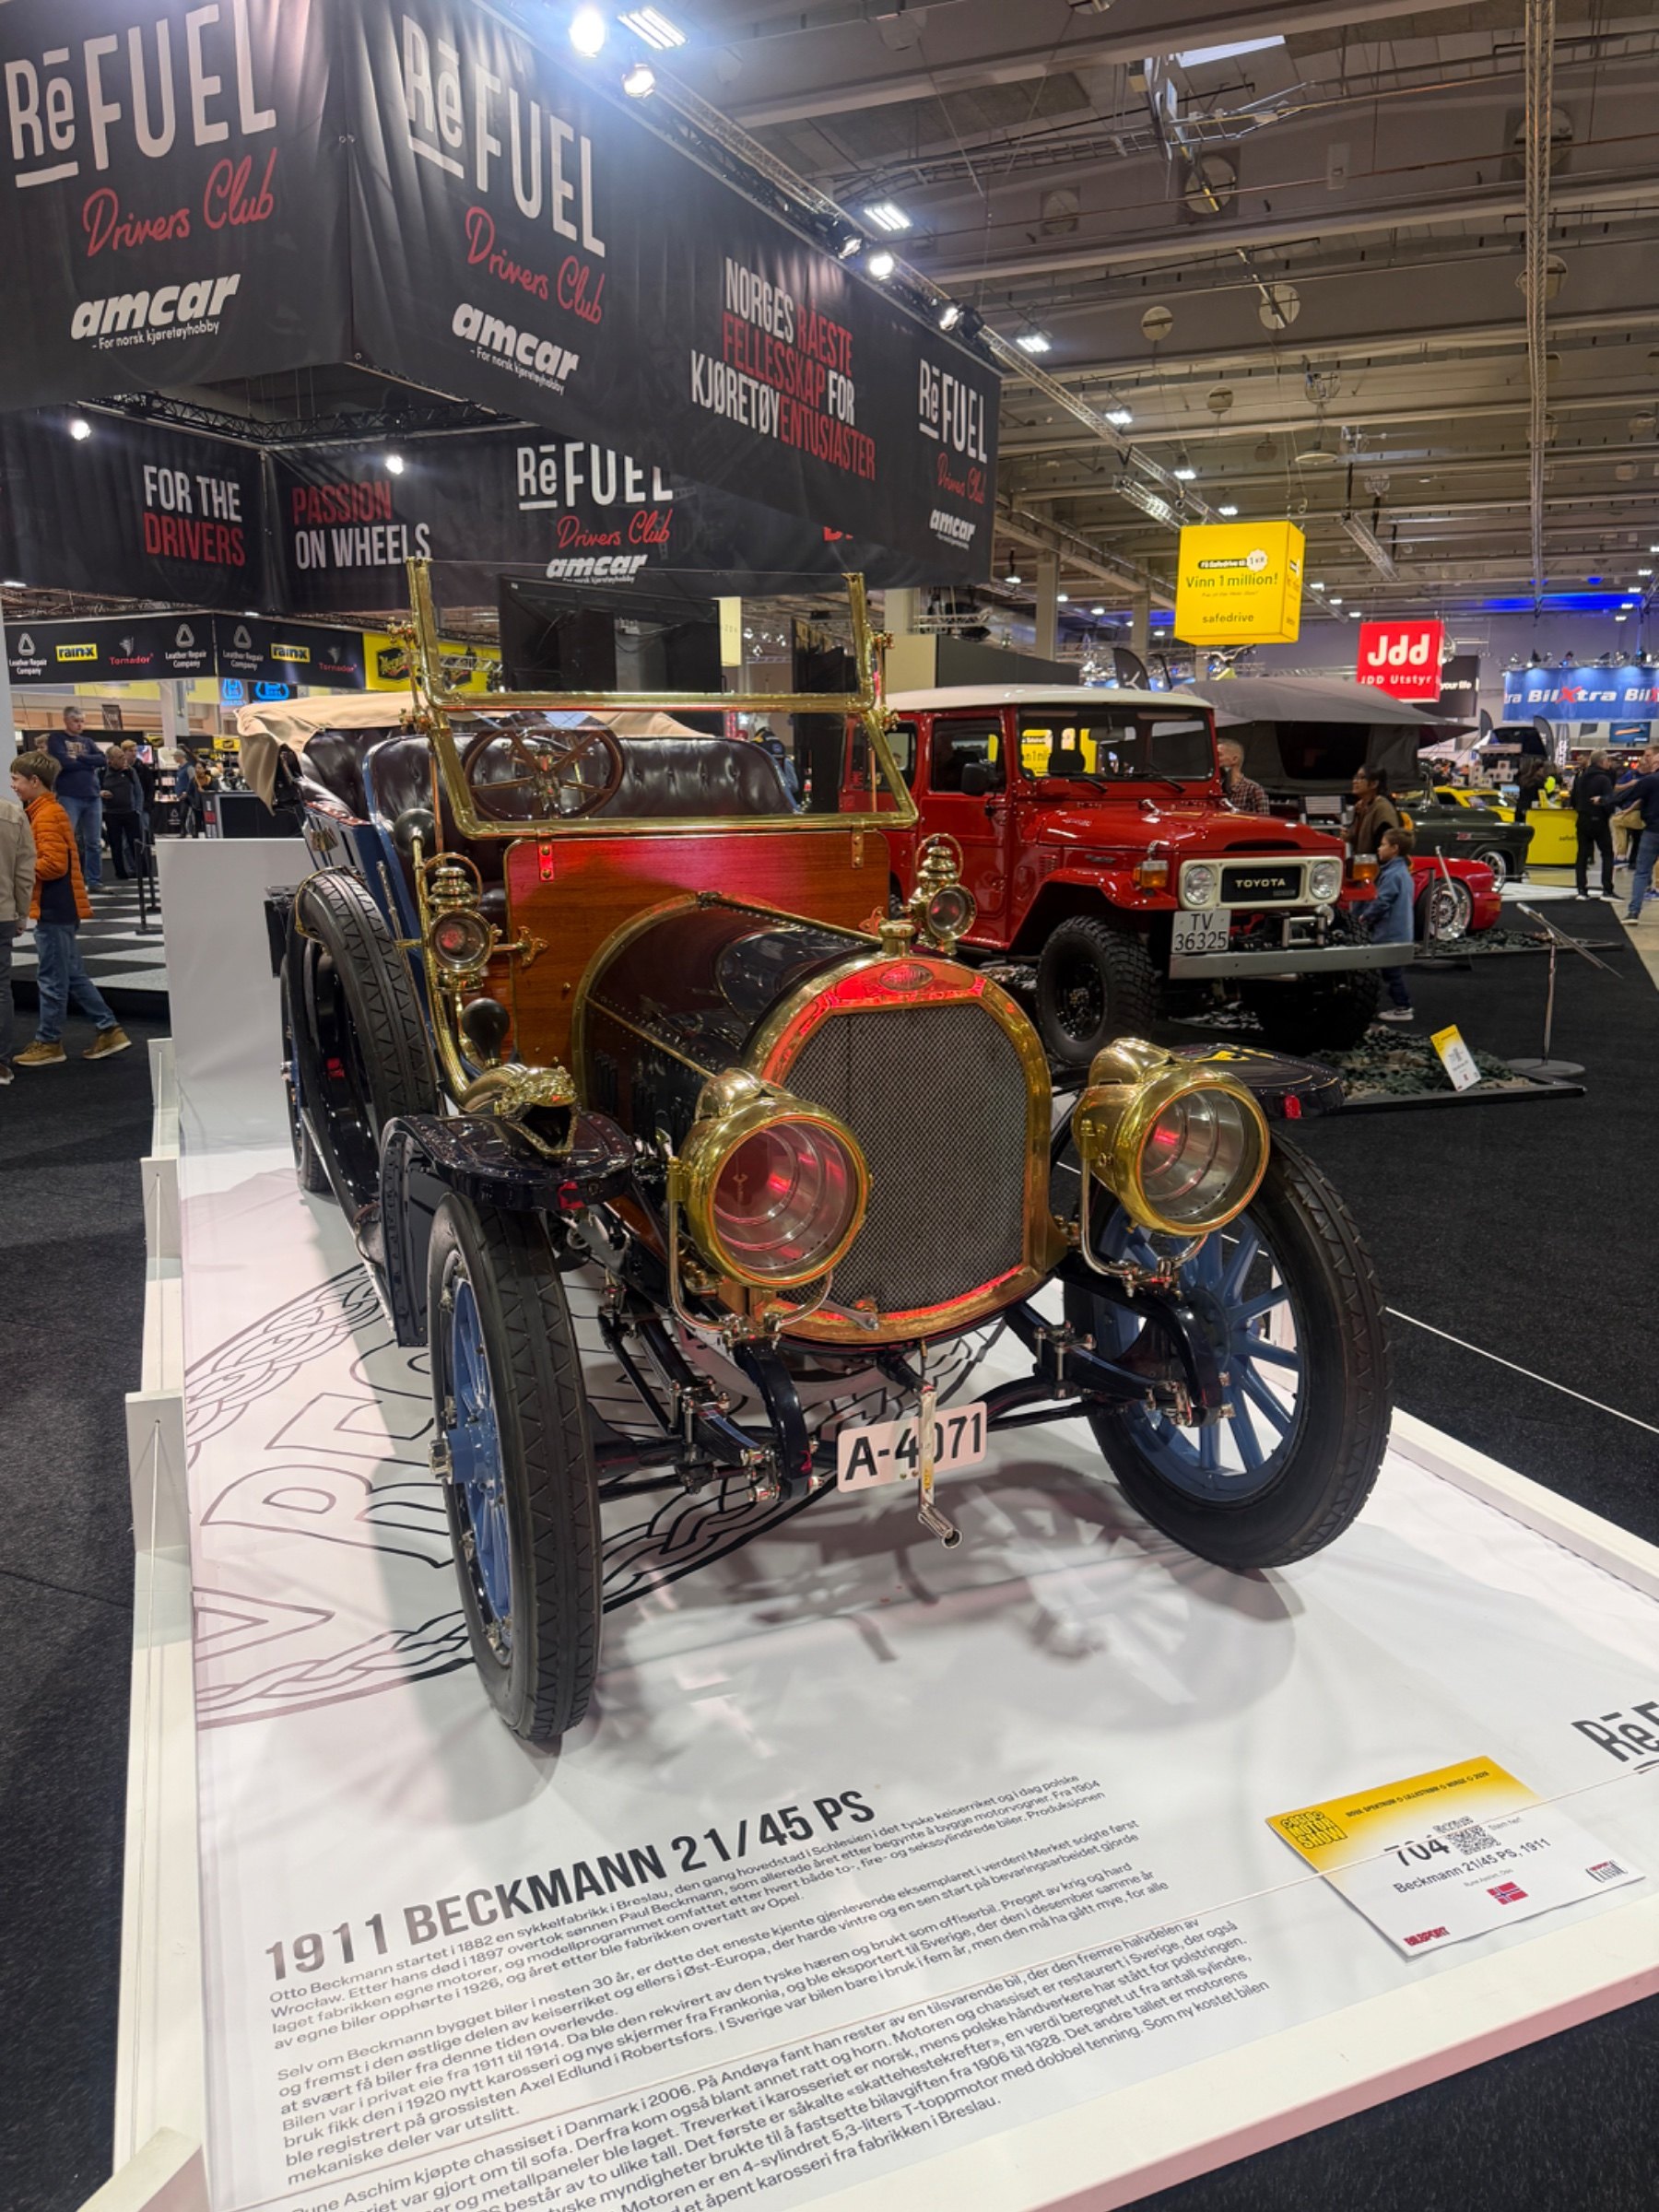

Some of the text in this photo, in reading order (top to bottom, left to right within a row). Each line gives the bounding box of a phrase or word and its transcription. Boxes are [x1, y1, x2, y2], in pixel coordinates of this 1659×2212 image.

[82, 147, 276, 257] Drivers Club
[465, 206, 602, 324] Drivers Club
[70, 273, 241, 340] amcar
[724, 255, 853, 378] NORGES RÅESTE
[98, 336, 114, 350] For
[116, 330, 145, 347] norsk
[146, 319, 219, 346] kjøretøyhobby
[452, 302, 581, 381] amcar
[477, 346, 491, 361] For
[722, 309, 855, 427] FELLESSKAP FOR
[690, 347, 876, 482] KJØRETØYENTUSIASTER
[143, 464, 243, 524] FOR THE
[291, 478, 394, 526] PASSION
[143, 512, 246, 568] DRIVERS
[557, 508, 674, 549] Drivers Club
[929, 509, 976, 543] amcar
[294, 522, 431, 571] ON WHEELS
[546, 554, 649, 580] amcar
[1186, 575, 1216, 588] Vinn
[1219, 575, 1225, 587] 1
[1227, 572, 1278, 586] million!
[1202, 613, 1254, 624] safedrive
[8, 658, 47, 667] Leather Repair
[110, 656, 151, 665] Tornador
[165, 650, 206, 660] Leather Repair
[172, 660, 201, 669] Company
[230, 660, 258, 671] Company
[1367, 634, 1430, 666] Jdd
[17, 667, 41, 677] Company
[1390, 674, 1432, 686] Utstyr
[1526, 686, 1617, 704] BilXtra
[1235, 878, 1286, 888] TOYOTA
[1191, 913, 1214, 931] TV
[1174, 931, 1227, 952] 36325
[1286, 1817, 1337, 1839] MOTOR
[1295, 1826, 1349, 1850] SHOW
[1384, 1834, 1450, 1866] 704
[1394, 1838, 1552, 1894] Beckmann 21/45 PS, 1911
[265, 1791, 875, 1981] 1911 BECKMANN 21/45 PS
[274, 2037, 293, 2050] av
[296, 2024, 338, 2043] egne
[340, 2013, 376, 2031] biler
[379, 1992, 453, 2020] opphørte
[462, 1976, 503, 1995] 1926,
[505, 1971, 526, 1984] og
[528, 1960, 559, 1978] året
[560, 1949, 598, 1969] etter
[598, 1943, 623, 1958] ble
[623, 1924, 691, 1949] fabrikken
[690, 1906, 748, 1931] overtatt
[748, 1902, 766, 1914] av
[766, 1890, 804, 1909] Opel.
[280, 2007, 618, 2115] at svært få biler fra denne tiden overlevde.
[292, 2199, 339, 2212] une
[343, 2176, 411, 2206] Aschim
[413, 2158, 470, 2184] kjøpte
[473, 2129, 556, 2165] chassiset
[563, 2100, 640, 2136] Danmark
[646, 2083, 696, 2108] 2006.
[696, 2074, 719, 2091] På
[721, 2056, 780, 2085] Andøya
[779, 2044, 813, 2064] fant
[810, 2036, 842, 2053] han
[841, 2020, 886, 2043] rester
[888, 2014, 905, 2028] av
[906, 2008, 927, 2021] en
[925, 1982, 1005, 2015] tilsvarende
[1001, 1973, 1028, 1989] bil,
[1026, 1967, 1050, 1982] der
[1050, 1959, 1078, 1974] den
[1076, 1943, 1124, 1965] fremre
[1120, 1924, 1184, 1950] halvdelen
[1182, 1915, 1195, 1928] av
[620, 1981, 1270, 2212] Motoren er en 4-sylindret 5,3-liters T-toppmotor med dobbel tenning. Som ny kostet bilen
[288, 2104, 519, 2185] mekaniske deler var utslitt.
[704, 2180, 757, 2208] åpent
[755, 2151, 832, 2191] karosseri
[831, 2146, 857, 2163] fra
[856, 2119, 932, 2154] fabrikken
[936, 2096, 1001, 2124] Breslau.
